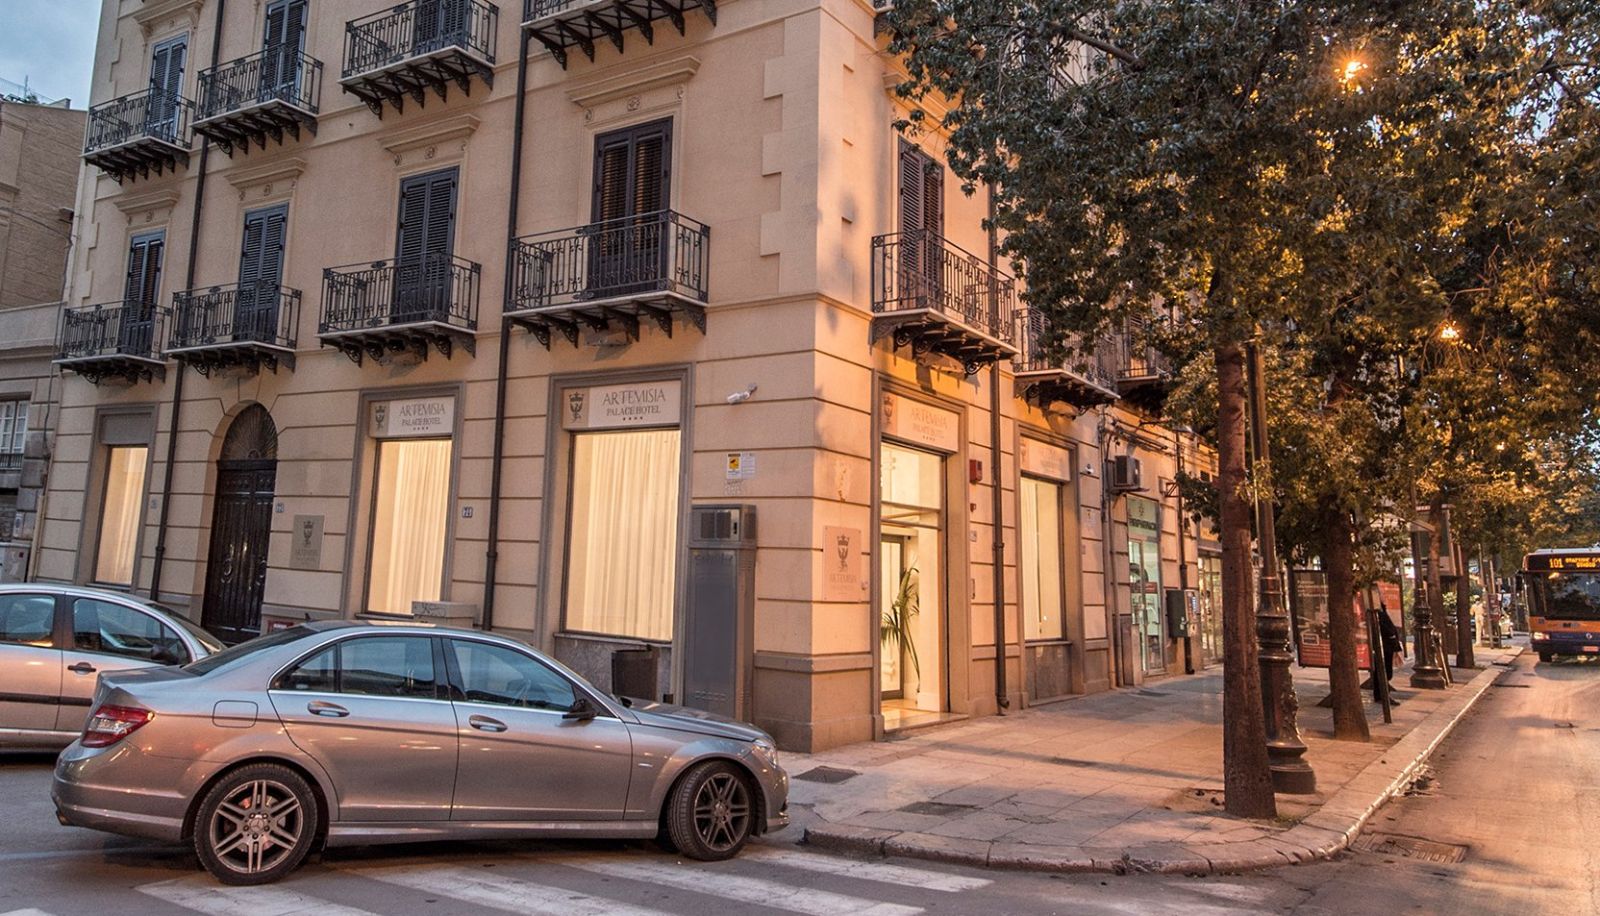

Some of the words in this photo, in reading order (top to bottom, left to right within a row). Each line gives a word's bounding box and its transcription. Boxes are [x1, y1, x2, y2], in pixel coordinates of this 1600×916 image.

[601, 388, 666, 406] ARTEMISIA
[399, 403, 446, 417] ARTEMISIA
[606, 407, 635, 416] PALACE
[636, 405, 660, 414] HOTEL
[402, 418, 423, 427] PALACE
[423, 417, 442, 425] HOTEL
[1549, 558, 1564, 569] 101
